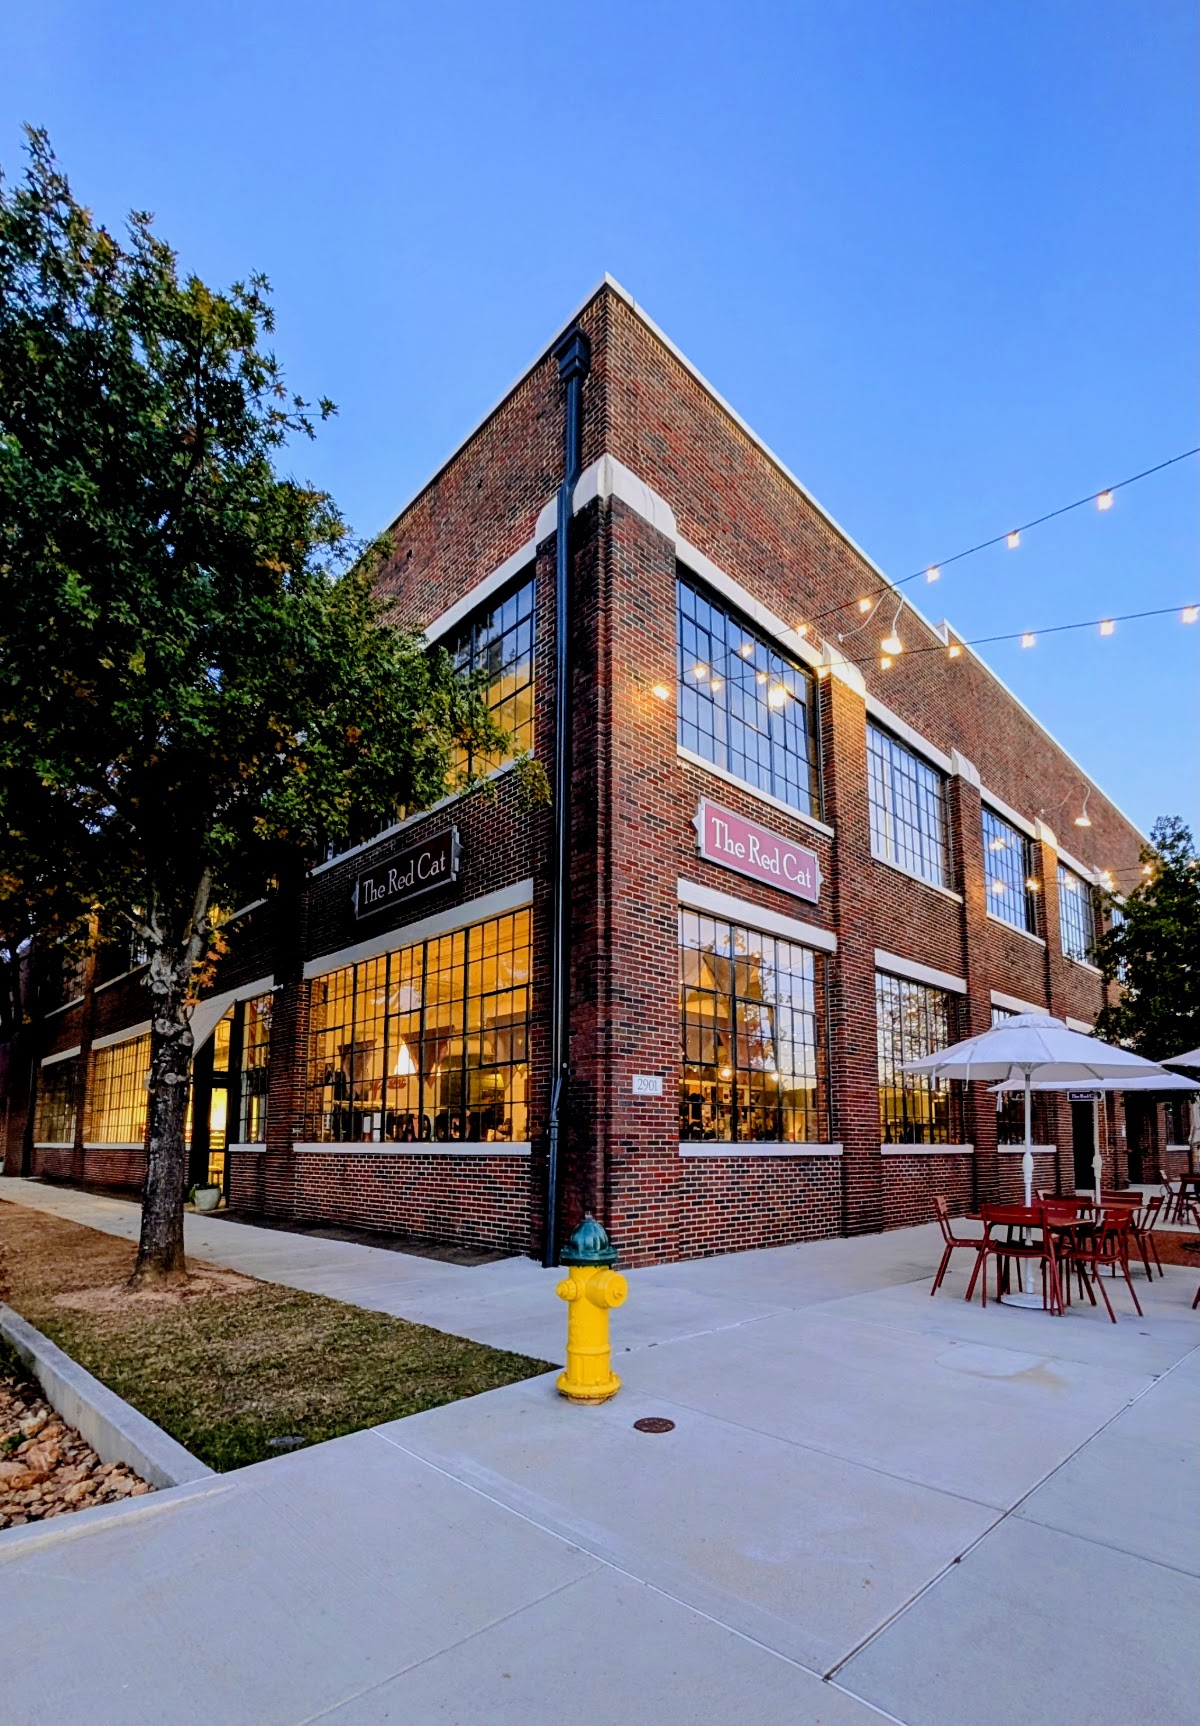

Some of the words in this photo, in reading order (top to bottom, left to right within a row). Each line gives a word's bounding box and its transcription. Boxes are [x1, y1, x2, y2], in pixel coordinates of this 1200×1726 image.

[363, 879, 386, 904] The
[387, 860, 415, 895] Red
[417, 851, 446, 879] Cat
[711, 817, 746, 858] The
[747, 834, 781, 875] Red
[783, 853, 812, 889] Cat
[637, 1078, 658, 1091] 2901
